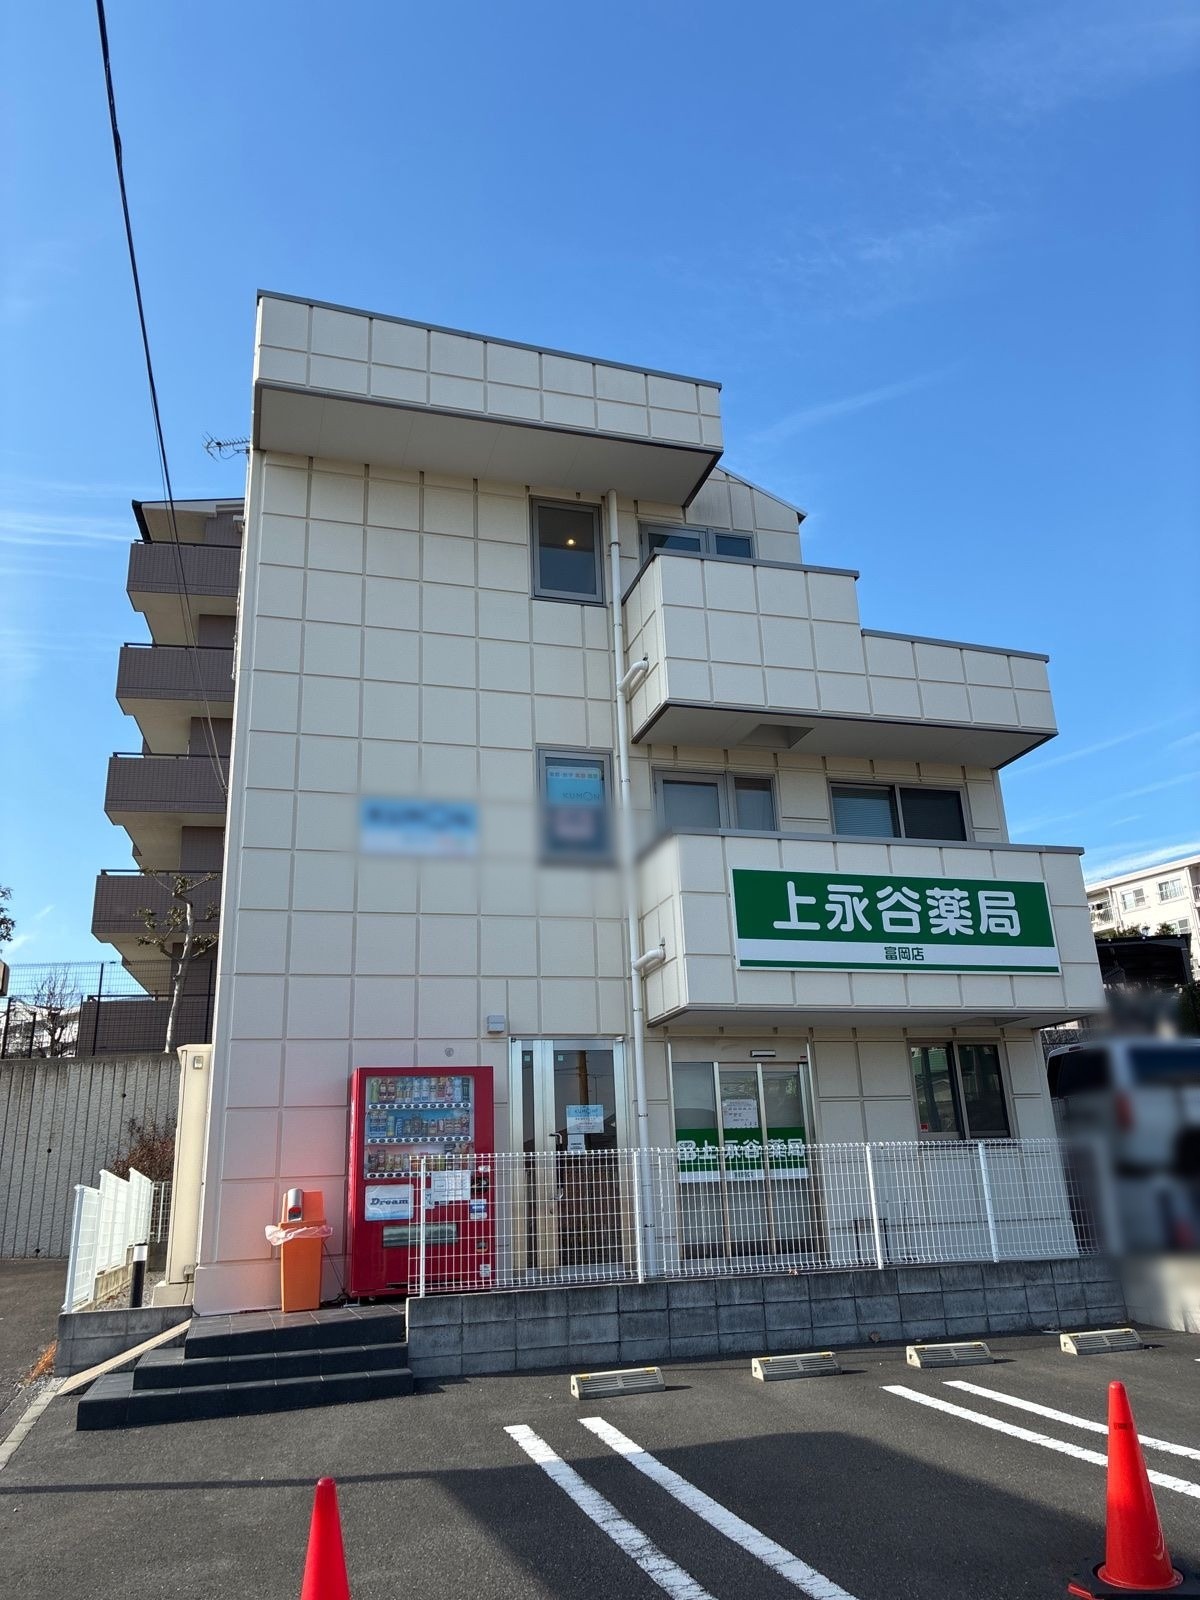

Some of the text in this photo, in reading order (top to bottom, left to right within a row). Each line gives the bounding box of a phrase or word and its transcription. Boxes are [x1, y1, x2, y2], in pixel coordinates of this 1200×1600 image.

[773, 880, 1021, 937] 上永谷薬局
[884, 946, 925, 961] 富岡店
[370, 1197, 409, 1206] Dream
